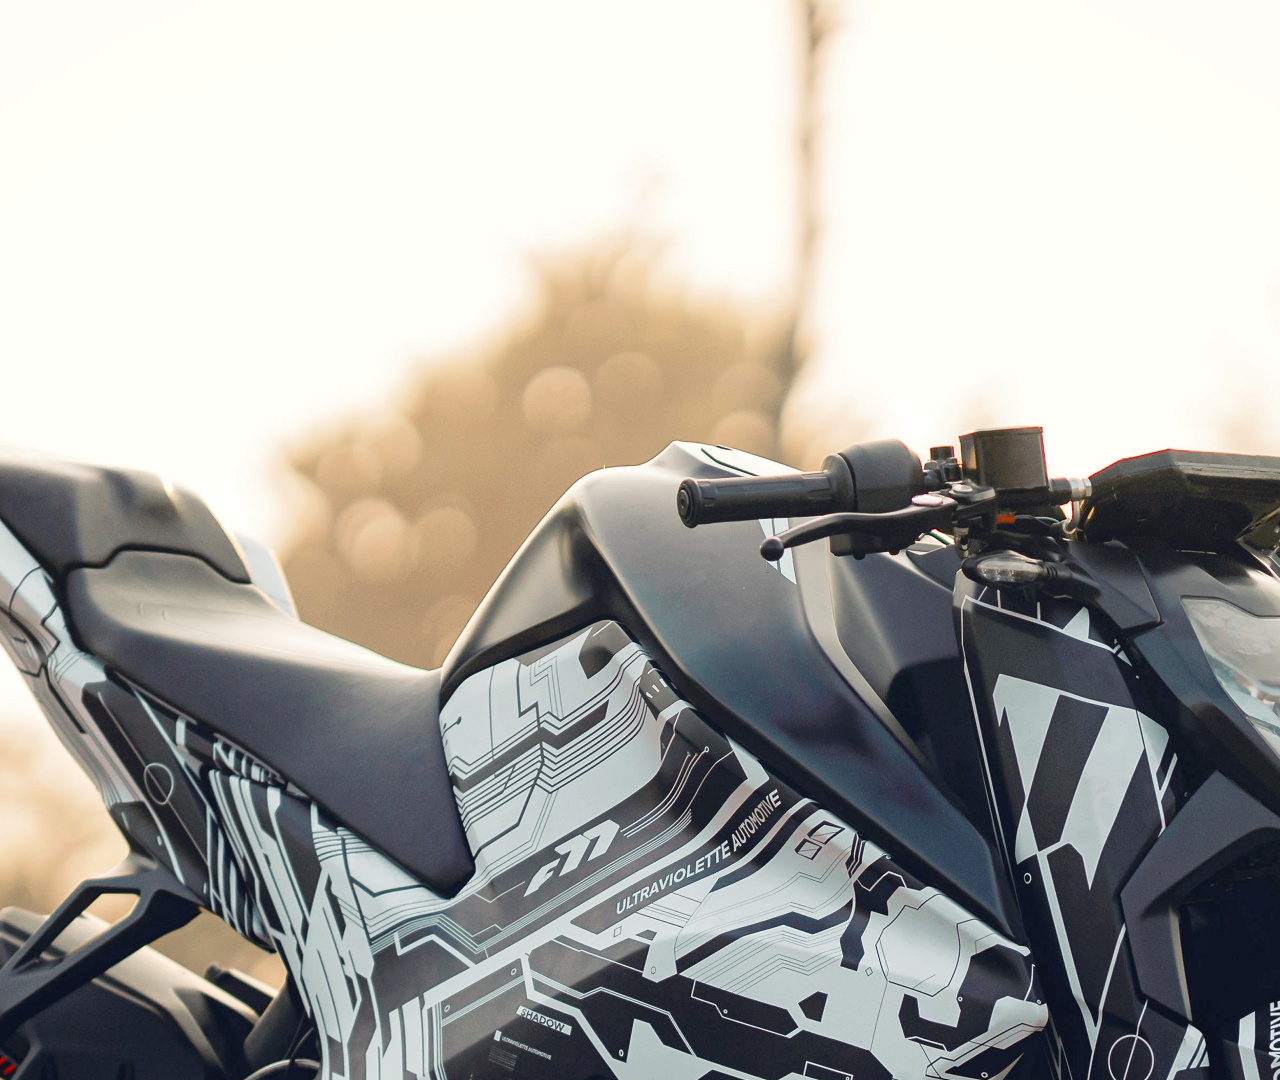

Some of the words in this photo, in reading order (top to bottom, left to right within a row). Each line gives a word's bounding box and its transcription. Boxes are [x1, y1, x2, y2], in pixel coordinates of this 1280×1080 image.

[616, 840, 731, 915] ULTRAVIOLETTE
[731, 788, 781, 852] AUTOMOTIVE
[520, 1008, 565, 1032] SHADOW
